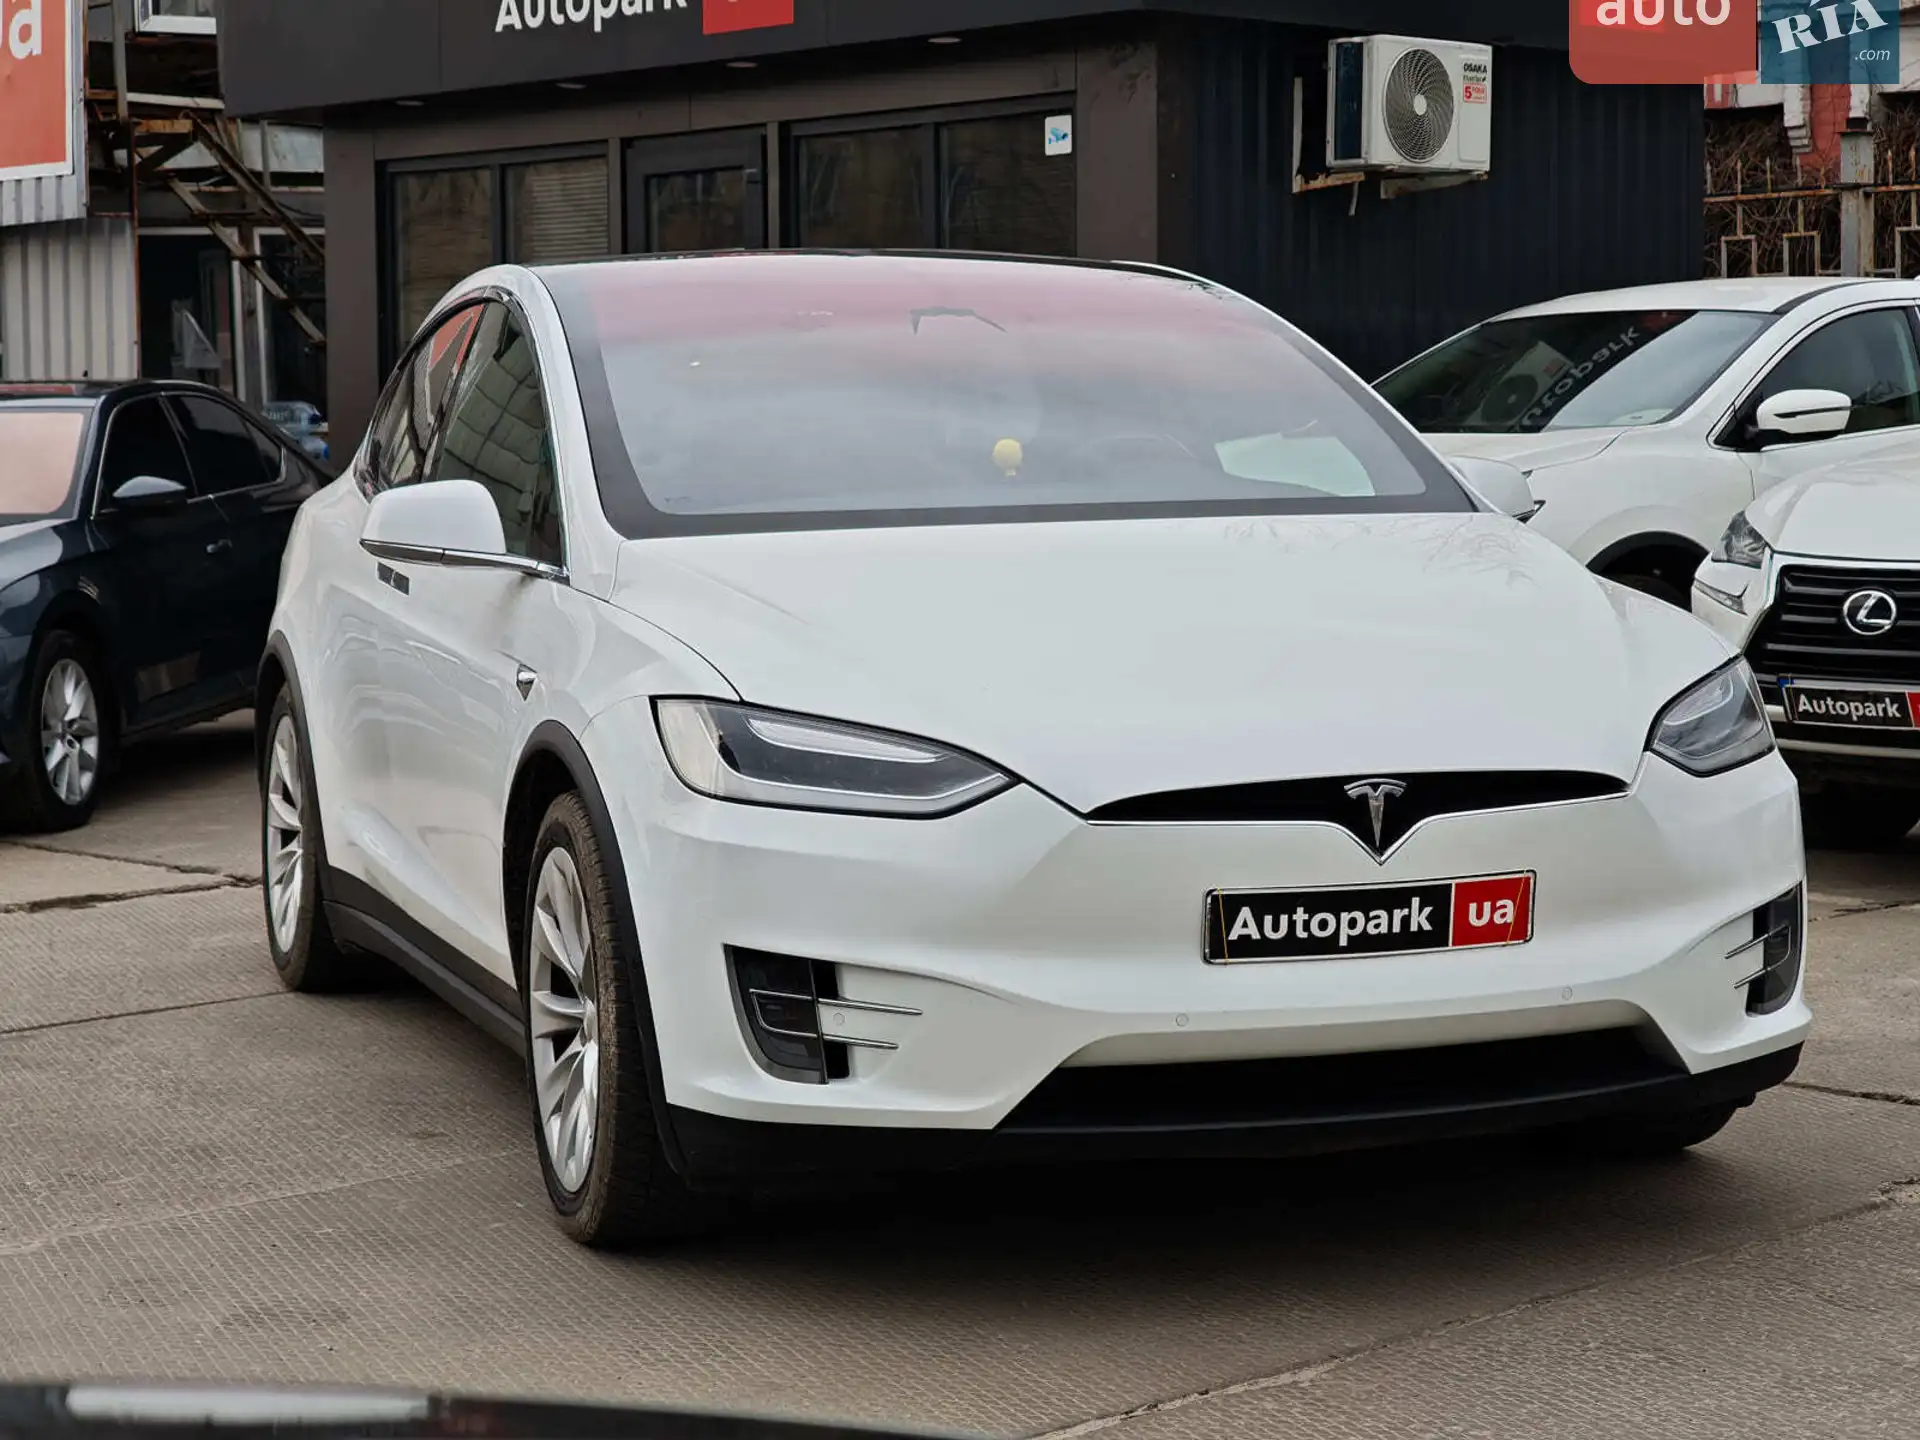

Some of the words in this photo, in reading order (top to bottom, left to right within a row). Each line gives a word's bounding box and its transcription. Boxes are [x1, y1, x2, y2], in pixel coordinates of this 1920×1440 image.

[1463, 62, 1488, 74] OSAKA
[1465, 86, 1472, 99] 5
[1798, 693, 1901, 721] Autopark
[1227, 896, 1434, 946] Autopark
[1467, 898, 1514, 927] ua
